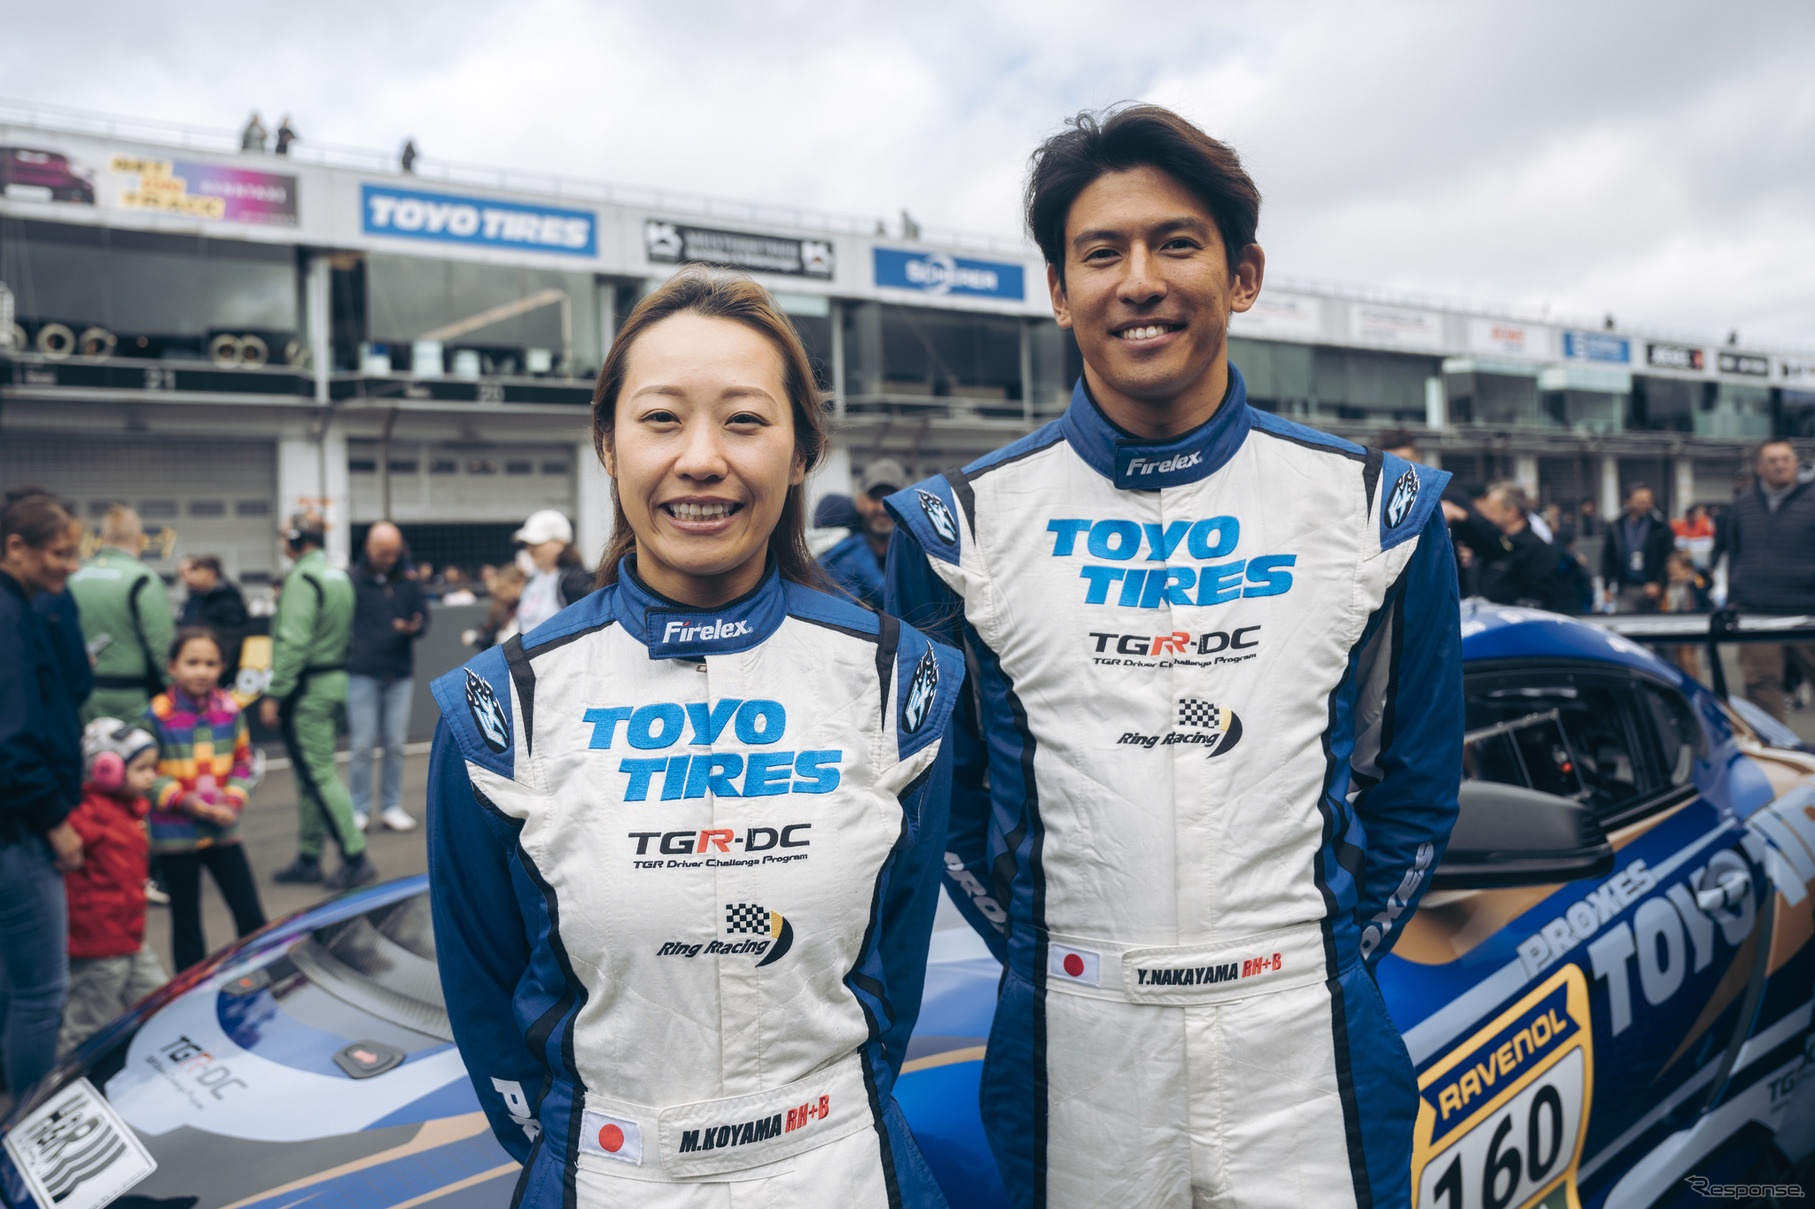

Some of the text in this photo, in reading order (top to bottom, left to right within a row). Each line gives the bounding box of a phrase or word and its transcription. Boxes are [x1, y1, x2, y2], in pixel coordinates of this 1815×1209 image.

[370, 195, 590, 249] TOYO TIRES
[1126, 450, 1201, 476] Firelex
[1046, 515, 1240, 561] TOYO
[1079, 554, 1297, 609] TIRES
[662, 619, 748, 643] Firelex
[1089, 625, 1261, 656] TGR-DC
[1093, 653, 1257, 669] TGR Driver Challenge Program
[582, 699, 786, 750] TOYO
[1116, 731, 1221, 749] Ring Racing
[618, 750, 843, 802] TIRES
[628, 823, 812, 855] TGR-DC
[633, 853, 808, 869] TGR Driver Challenge Program
[1516, 858, 1657, 981] PROXES
[1587, 848, 1757, 1038] TOYO
[656, 939, 771, 958] Ring Racing
[1137, 952, 1282, 986] Y.NAKAYAMA RH+B
[159, 1035, 248, 1101] TGR-DC
[1438, 1007, 1567, 1121] RAVENOL
[679, 1094, 830, 1153] M.KOYAMA RH+B
[1433, 1084, 1564, 1209] 160
